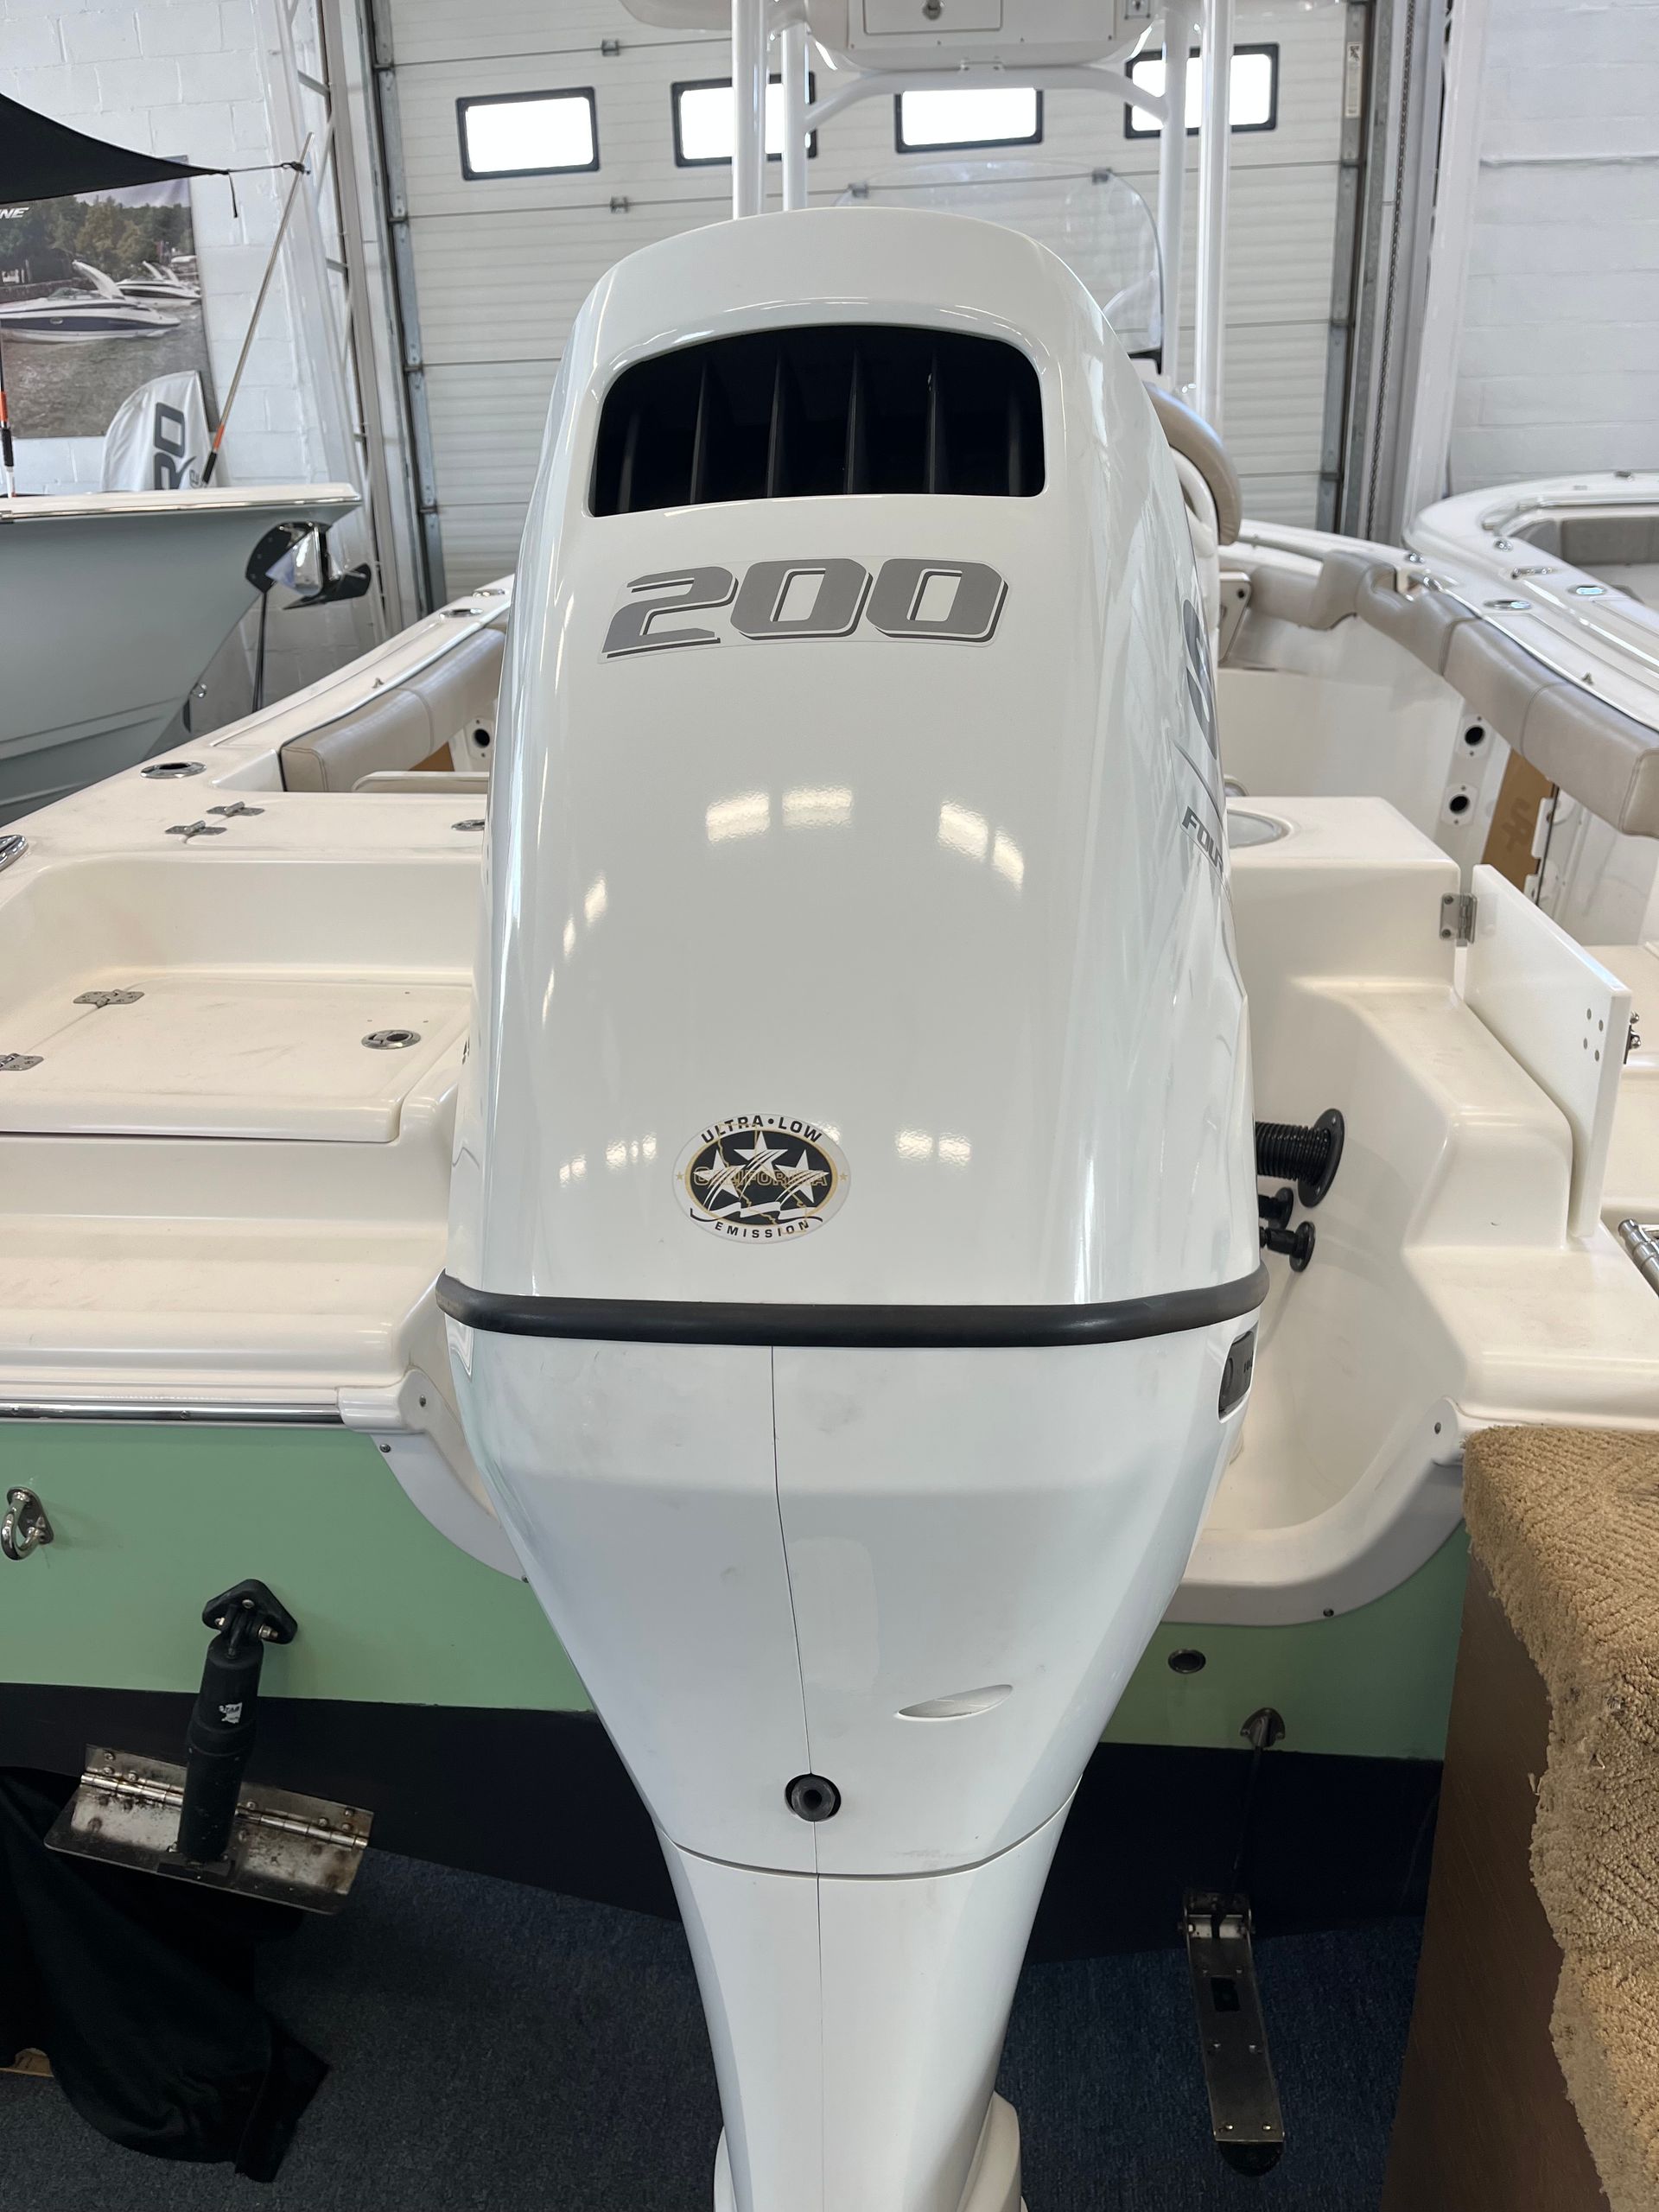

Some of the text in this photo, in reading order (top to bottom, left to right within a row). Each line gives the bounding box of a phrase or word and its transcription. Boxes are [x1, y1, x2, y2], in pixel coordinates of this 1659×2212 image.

[601, 557, 1008, 658] 200
[701, 1115, 823, 1143] ULTRA LOW
[715, 1220, 810, 1238] EMISSION
